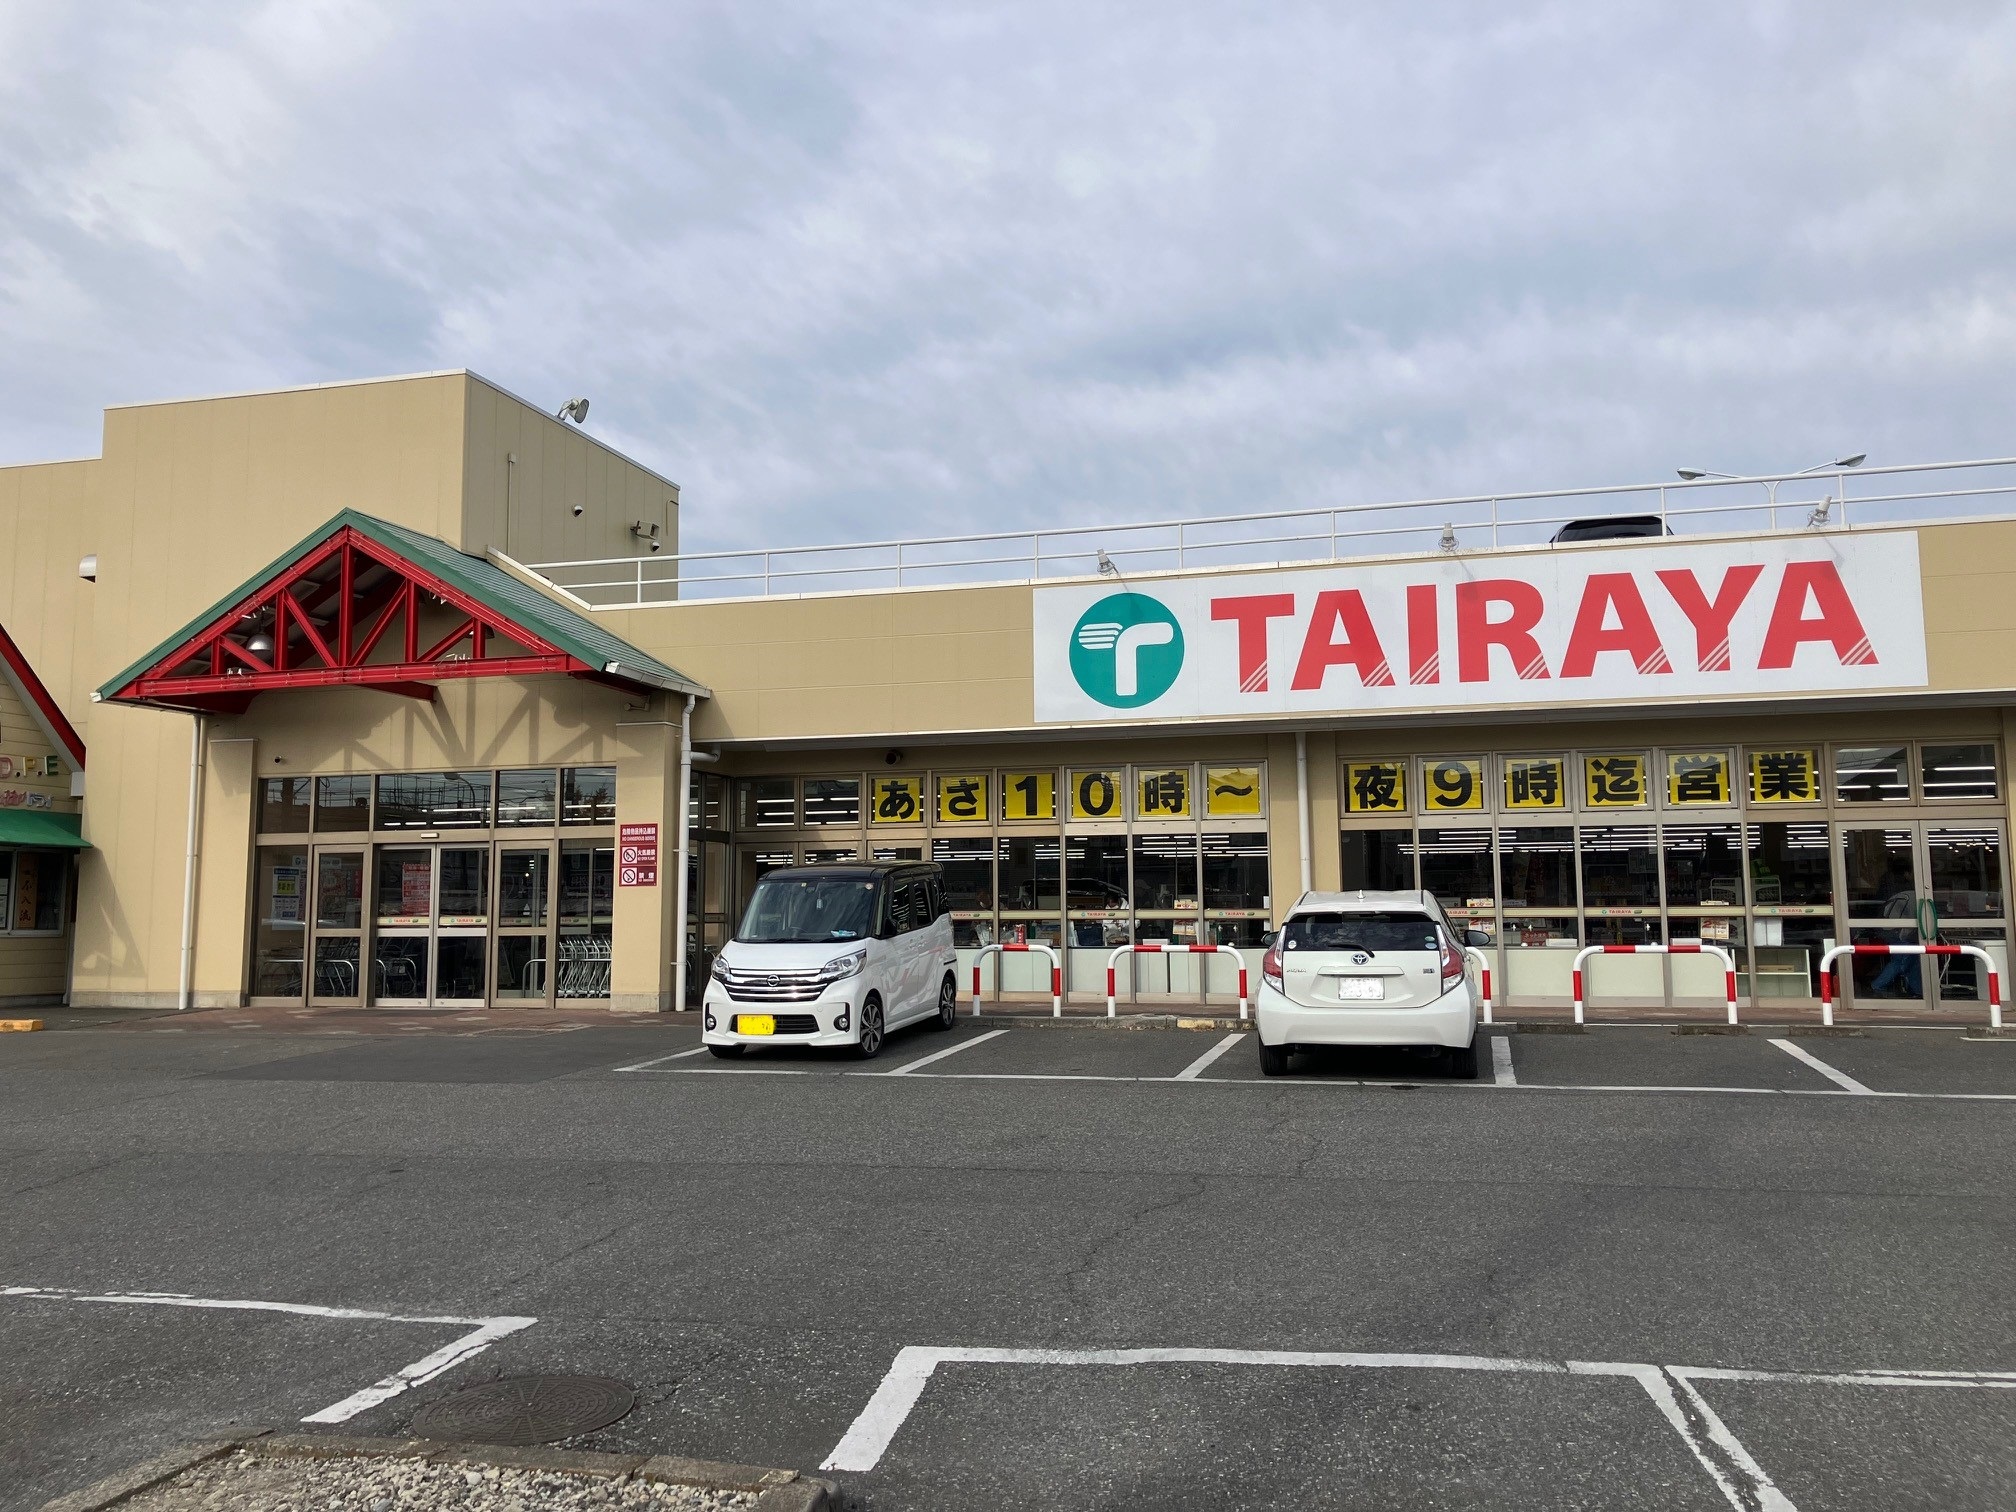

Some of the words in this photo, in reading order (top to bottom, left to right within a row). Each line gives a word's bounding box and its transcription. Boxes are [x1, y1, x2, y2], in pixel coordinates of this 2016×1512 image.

[1211, 560, 1879, 694] TAIRAYA
[1354, 752, 1810, 809] 夜9時迄営業
